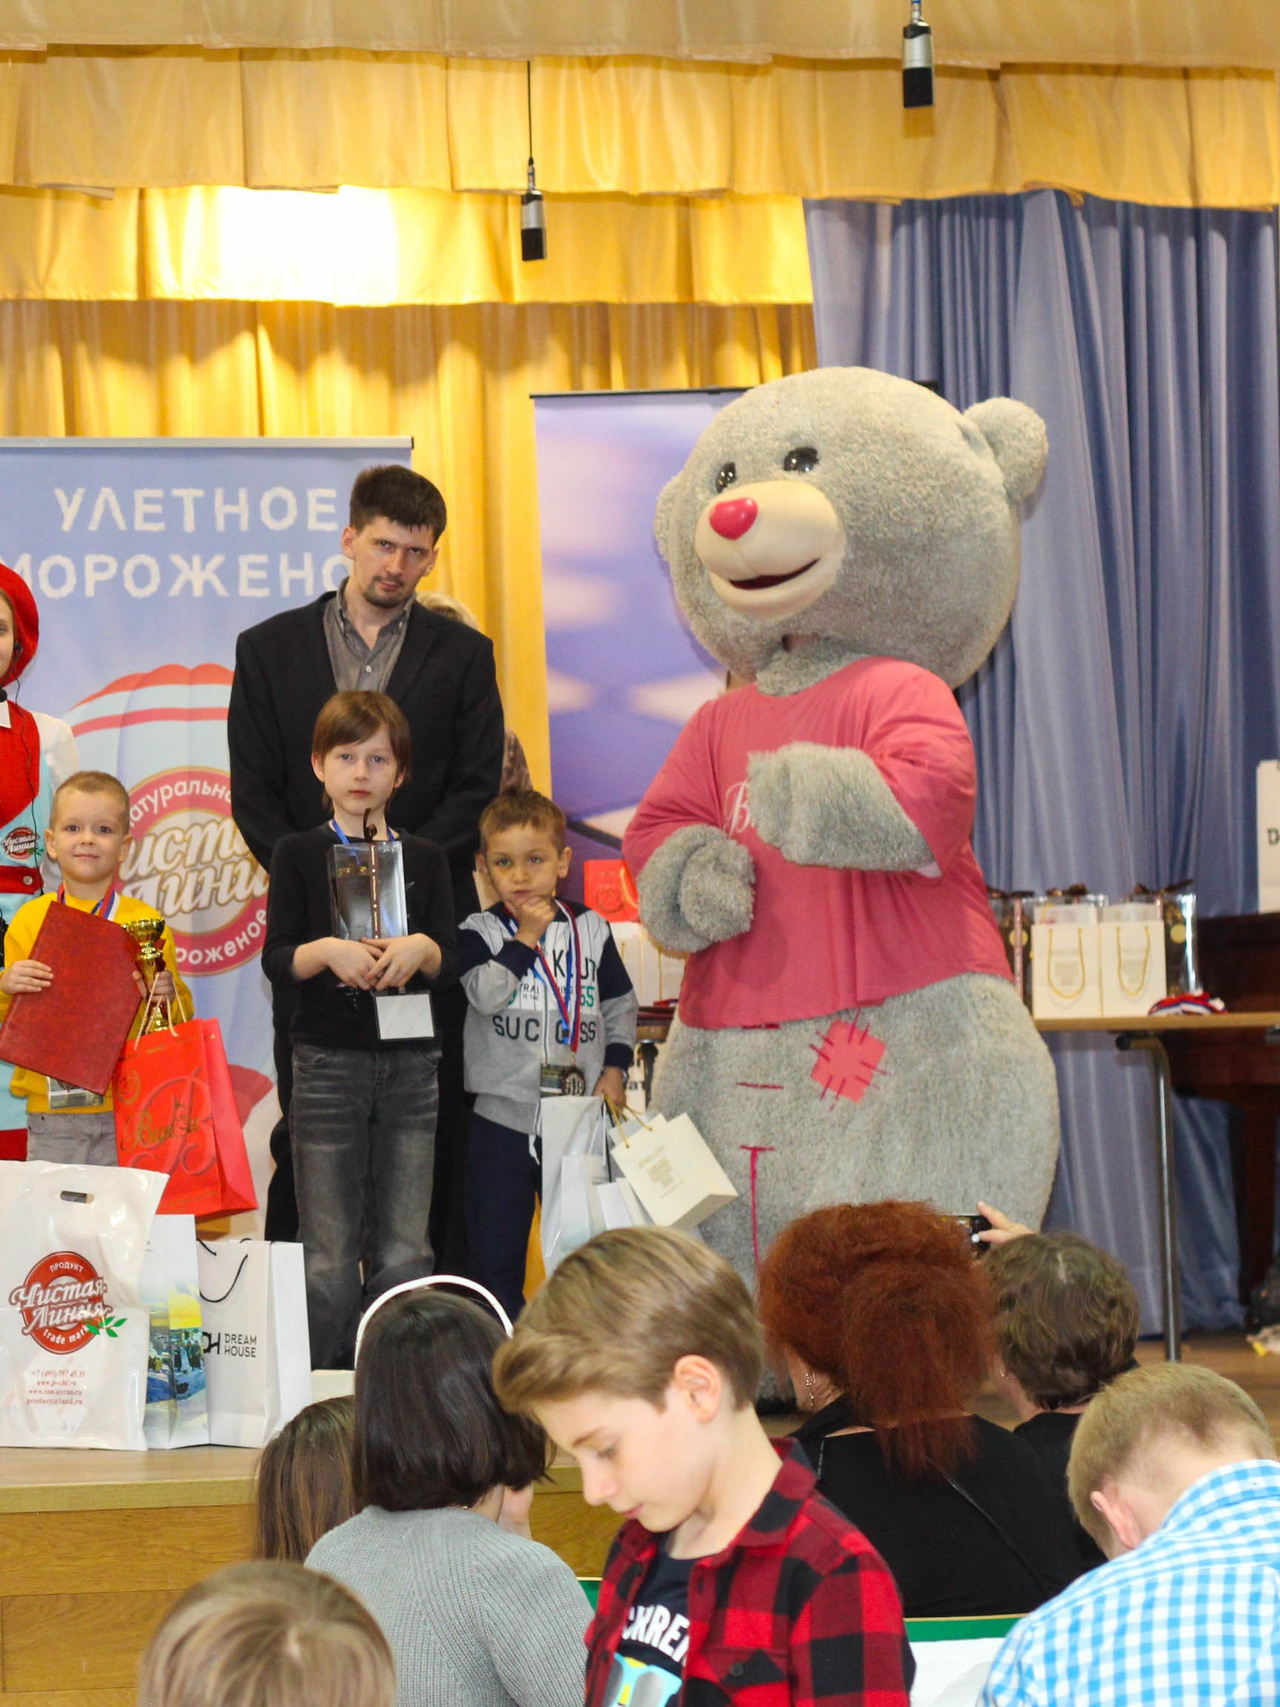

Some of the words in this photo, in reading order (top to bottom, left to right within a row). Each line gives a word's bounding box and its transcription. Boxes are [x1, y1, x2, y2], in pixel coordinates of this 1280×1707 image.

[53, 486, 339, 533] УЛЕТНОЕ
[49, 1260, 84, 1273] ПРОДУКТ
[9, 1276, 108, 1310] Чистая
[21, 1301, 113, 1336] Линия
[42, 1328, 66, 1345] trade
[224, 1333, 258, 1346] DREAM
[224, 1344, 257, 1358] HOUSE
